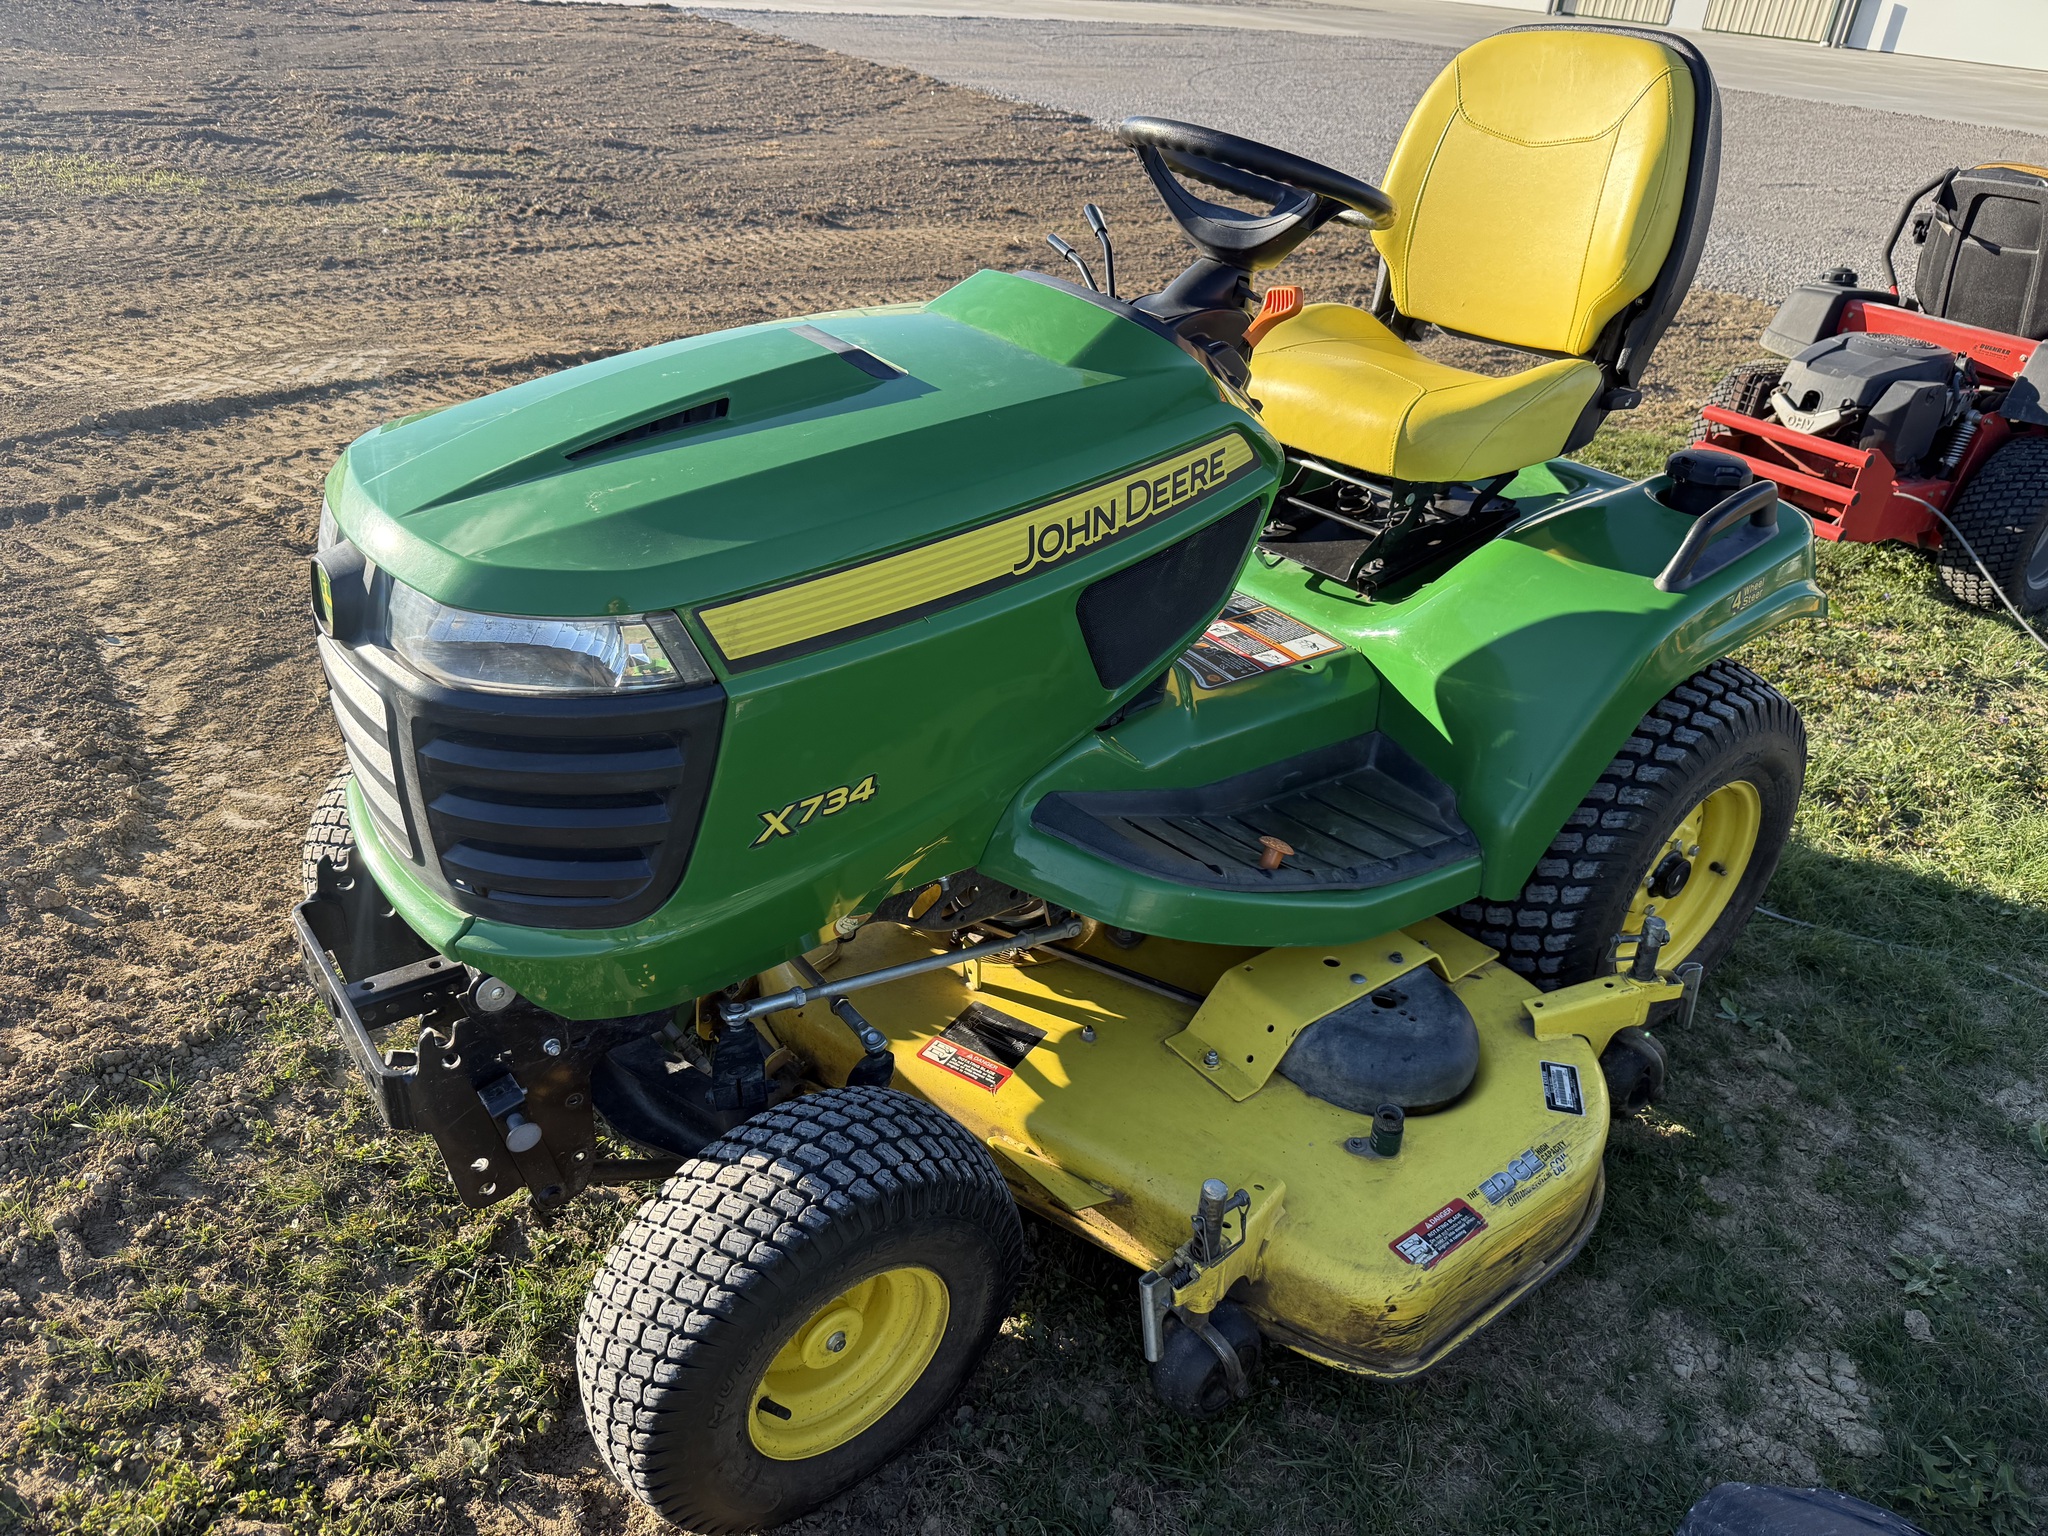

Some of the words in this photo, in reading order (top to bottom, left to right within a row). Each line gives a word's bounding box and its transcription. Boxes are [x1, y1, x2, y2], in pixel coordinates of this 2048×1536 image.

[1788, 415, 1814, 431] OHV
[1012, 498, 1117, 573] JOHN
[1126, 446, 1227, 524] DEERE
[1744, 577, 1765, 595] Wheel
[1732, 590, 1742, 609] 4
[1743, 589, 1763, 606] Steer
[751, 773, 877, 846] X734
[973, 1055, 998, 1070] DANGER
[1535, 1142, 1550, 1156] HIGH
[1540, 1140, 1567, 1162] CAPACITY
[1467, 1189, 1480, 1200] THE
[1478, 1148, 1546, 1206] EDGE
[1427, 1220, 1449, 1238] ROTATING
[1447, 1212, 1462, 1224] BLADE
[1428, 1206, 1453, 1225] DANGER
[707, 1314, 780, 1429] MULTI
